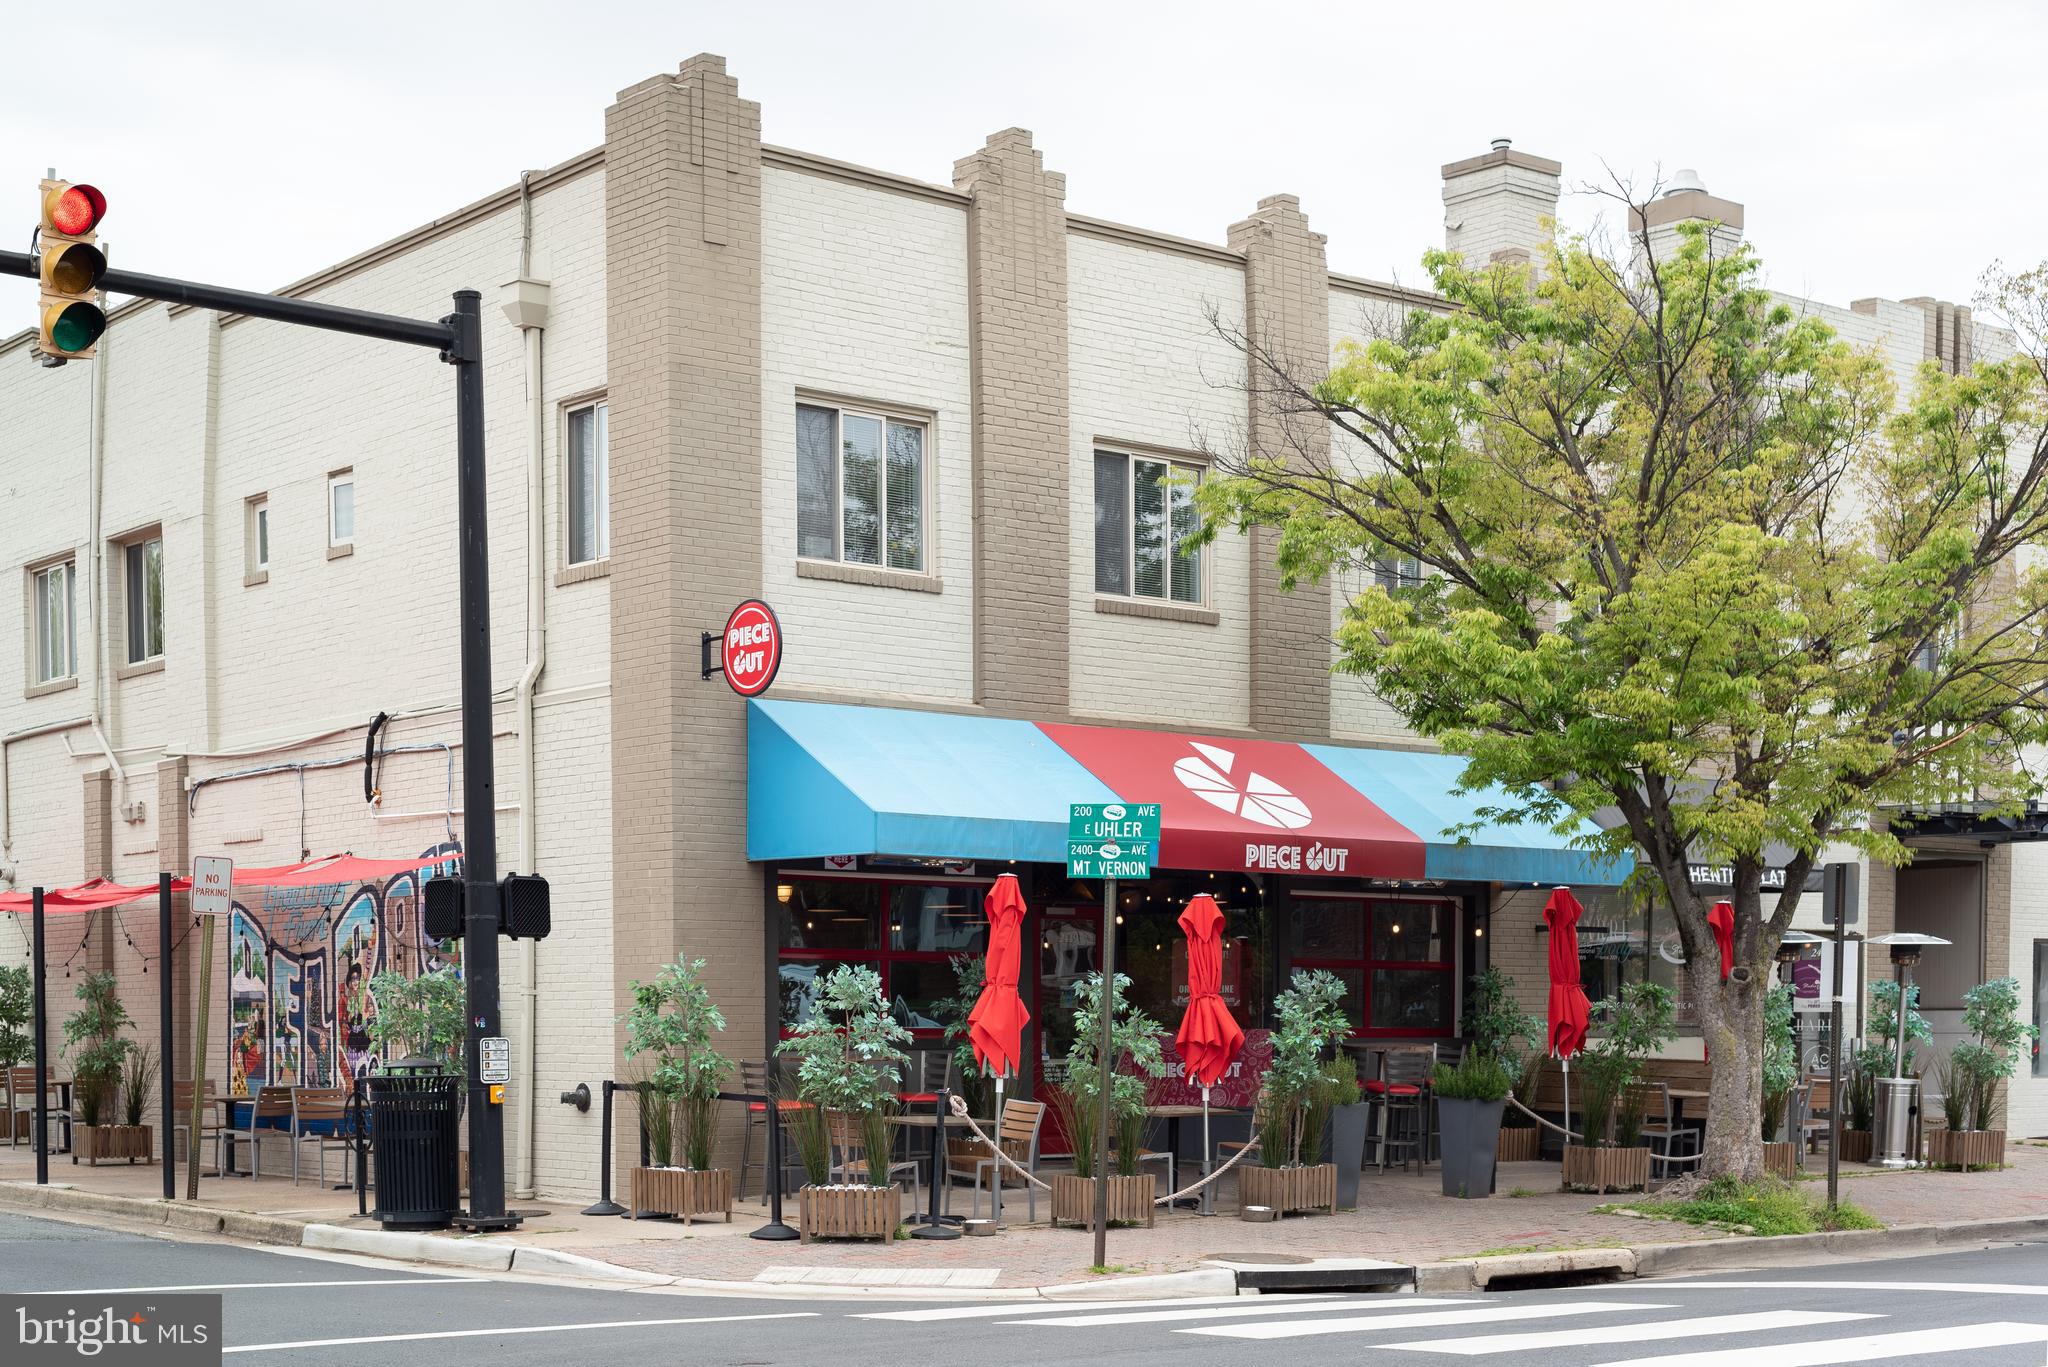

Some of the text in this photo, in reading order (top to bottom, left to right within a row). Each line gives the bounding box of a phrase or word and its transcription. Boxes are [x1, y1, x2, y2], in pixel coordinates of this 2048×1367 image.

[730, 622, 770, 648] PIECE
[1073, 806, 1156, 817] 200 AVE
[1084, 821, 1143, 837] E UHLER
[1071, 844, 1147, 855] 2400 AVE
[1245, 843, 1301, 870] PIECE
[1073, 860, 1146, 876] MT VERNON
[205, 873, 220, 884] NO
[195, 887, 228, 898] PARKING
